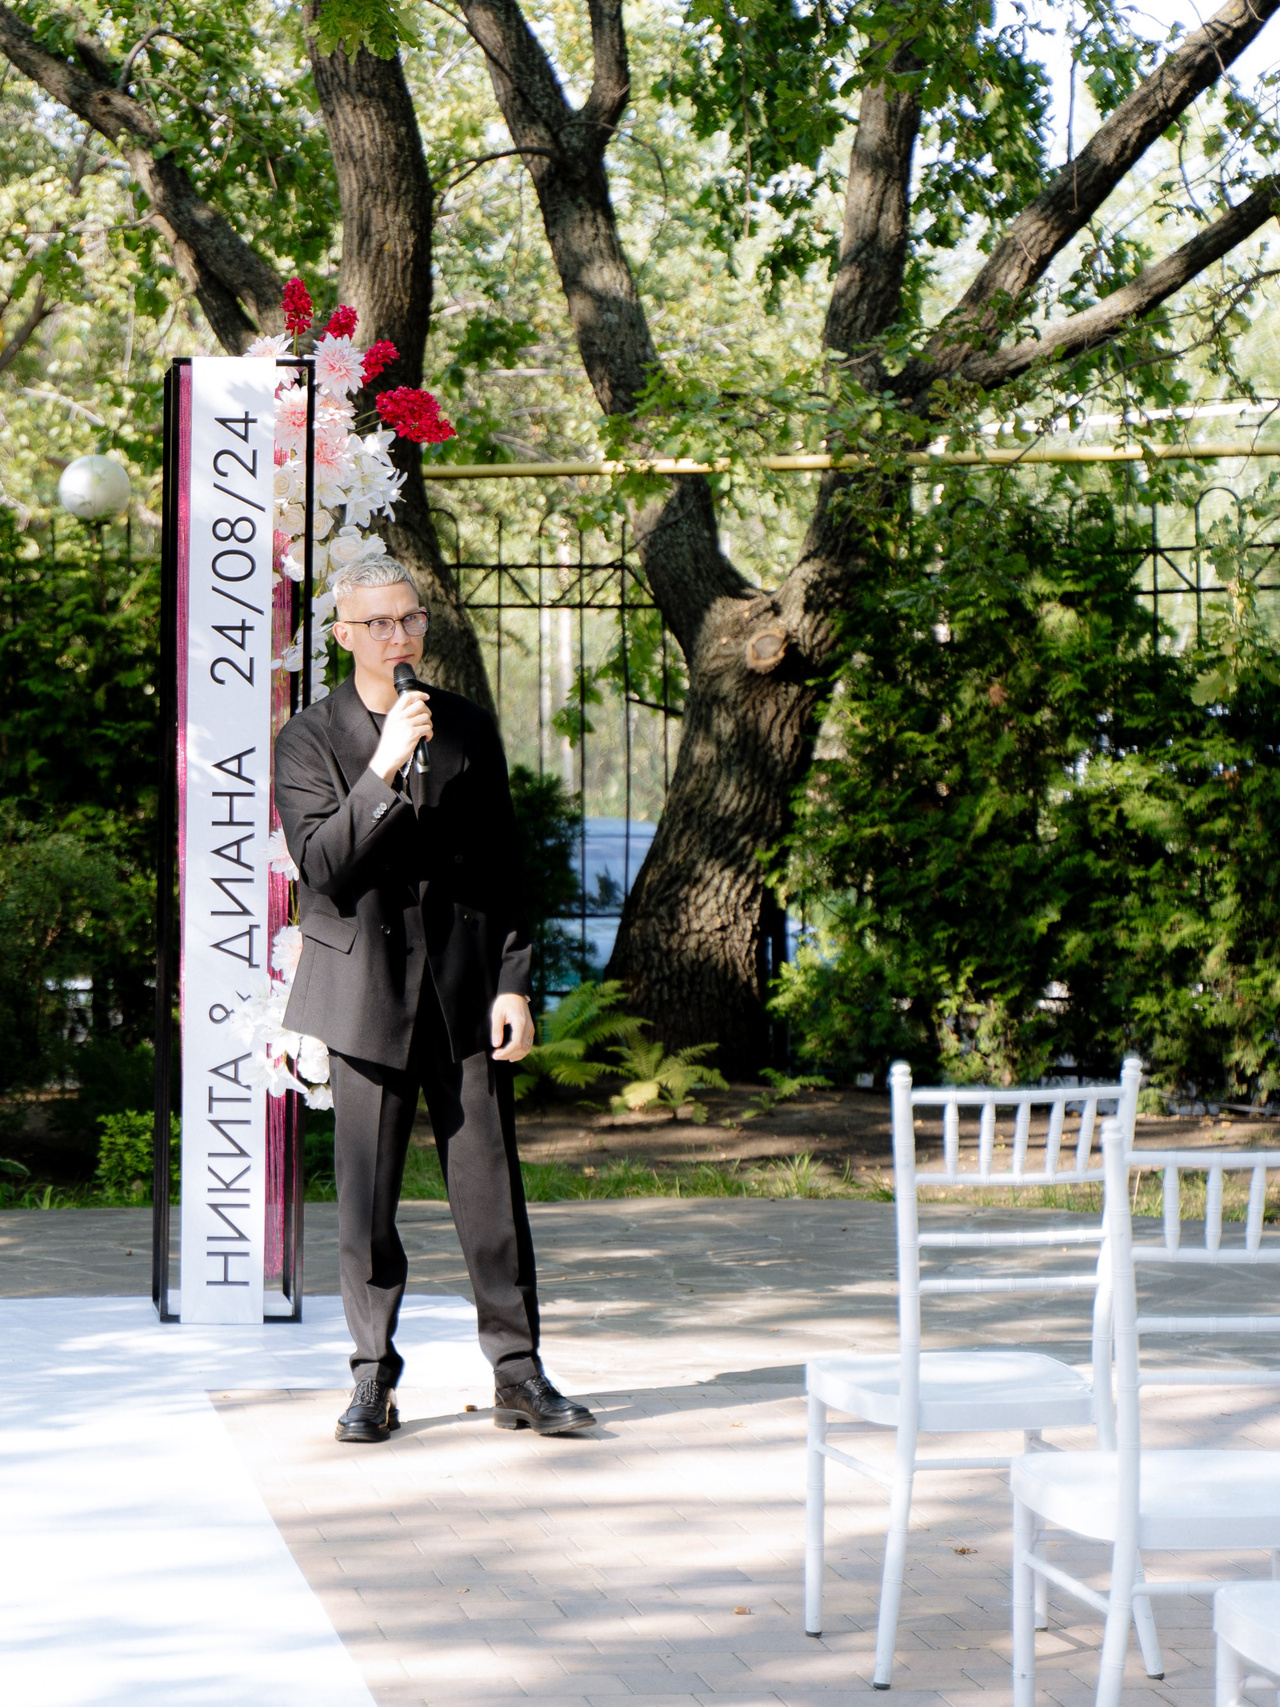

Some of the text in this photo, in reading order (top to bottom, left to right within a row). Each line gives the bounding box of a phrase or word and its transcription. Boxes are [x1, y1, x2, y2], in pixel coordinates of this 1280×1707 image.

[209, 410, 267, 688] 24/08/24
[209, 745, 262, 970] ДИАНА
[205, 1051, 253, 1288] НИКИТА
